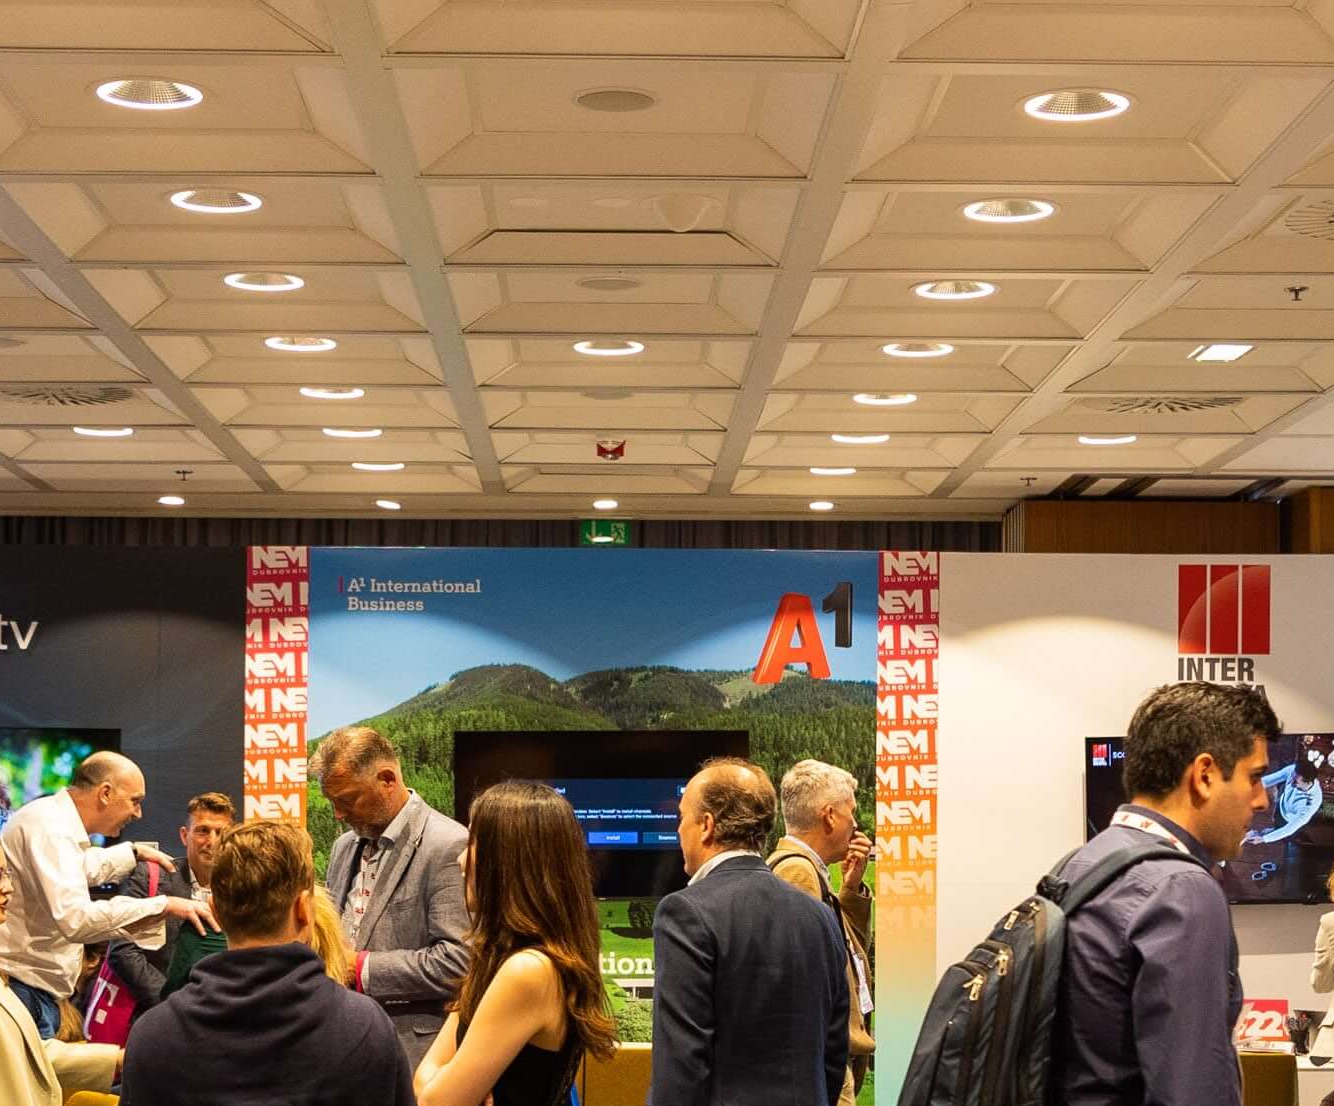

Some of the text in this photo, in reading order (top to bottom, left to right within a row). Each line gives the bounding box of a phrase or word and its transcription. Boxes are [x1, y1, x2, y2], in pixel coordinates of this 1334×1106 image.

[883, 552, 937, 576] NEM
[370, 578, 482, 593] International
[347, 596, 425, 611] Business
[900, 624, 939, 649] NE
[1178, 658, 1254, 681] INTER
[271, 687, 307, 712] NE
[903, 694, 938, 720] NE
[245, 723, 298, 748] NEM
[876, 729, 929, 754] NEM
[274, 758, 307, 782] NE
[905, 764, 937, 789] NE
[245, 793, 300, 819] NEM
[877, 800, 931, 825] NEM
